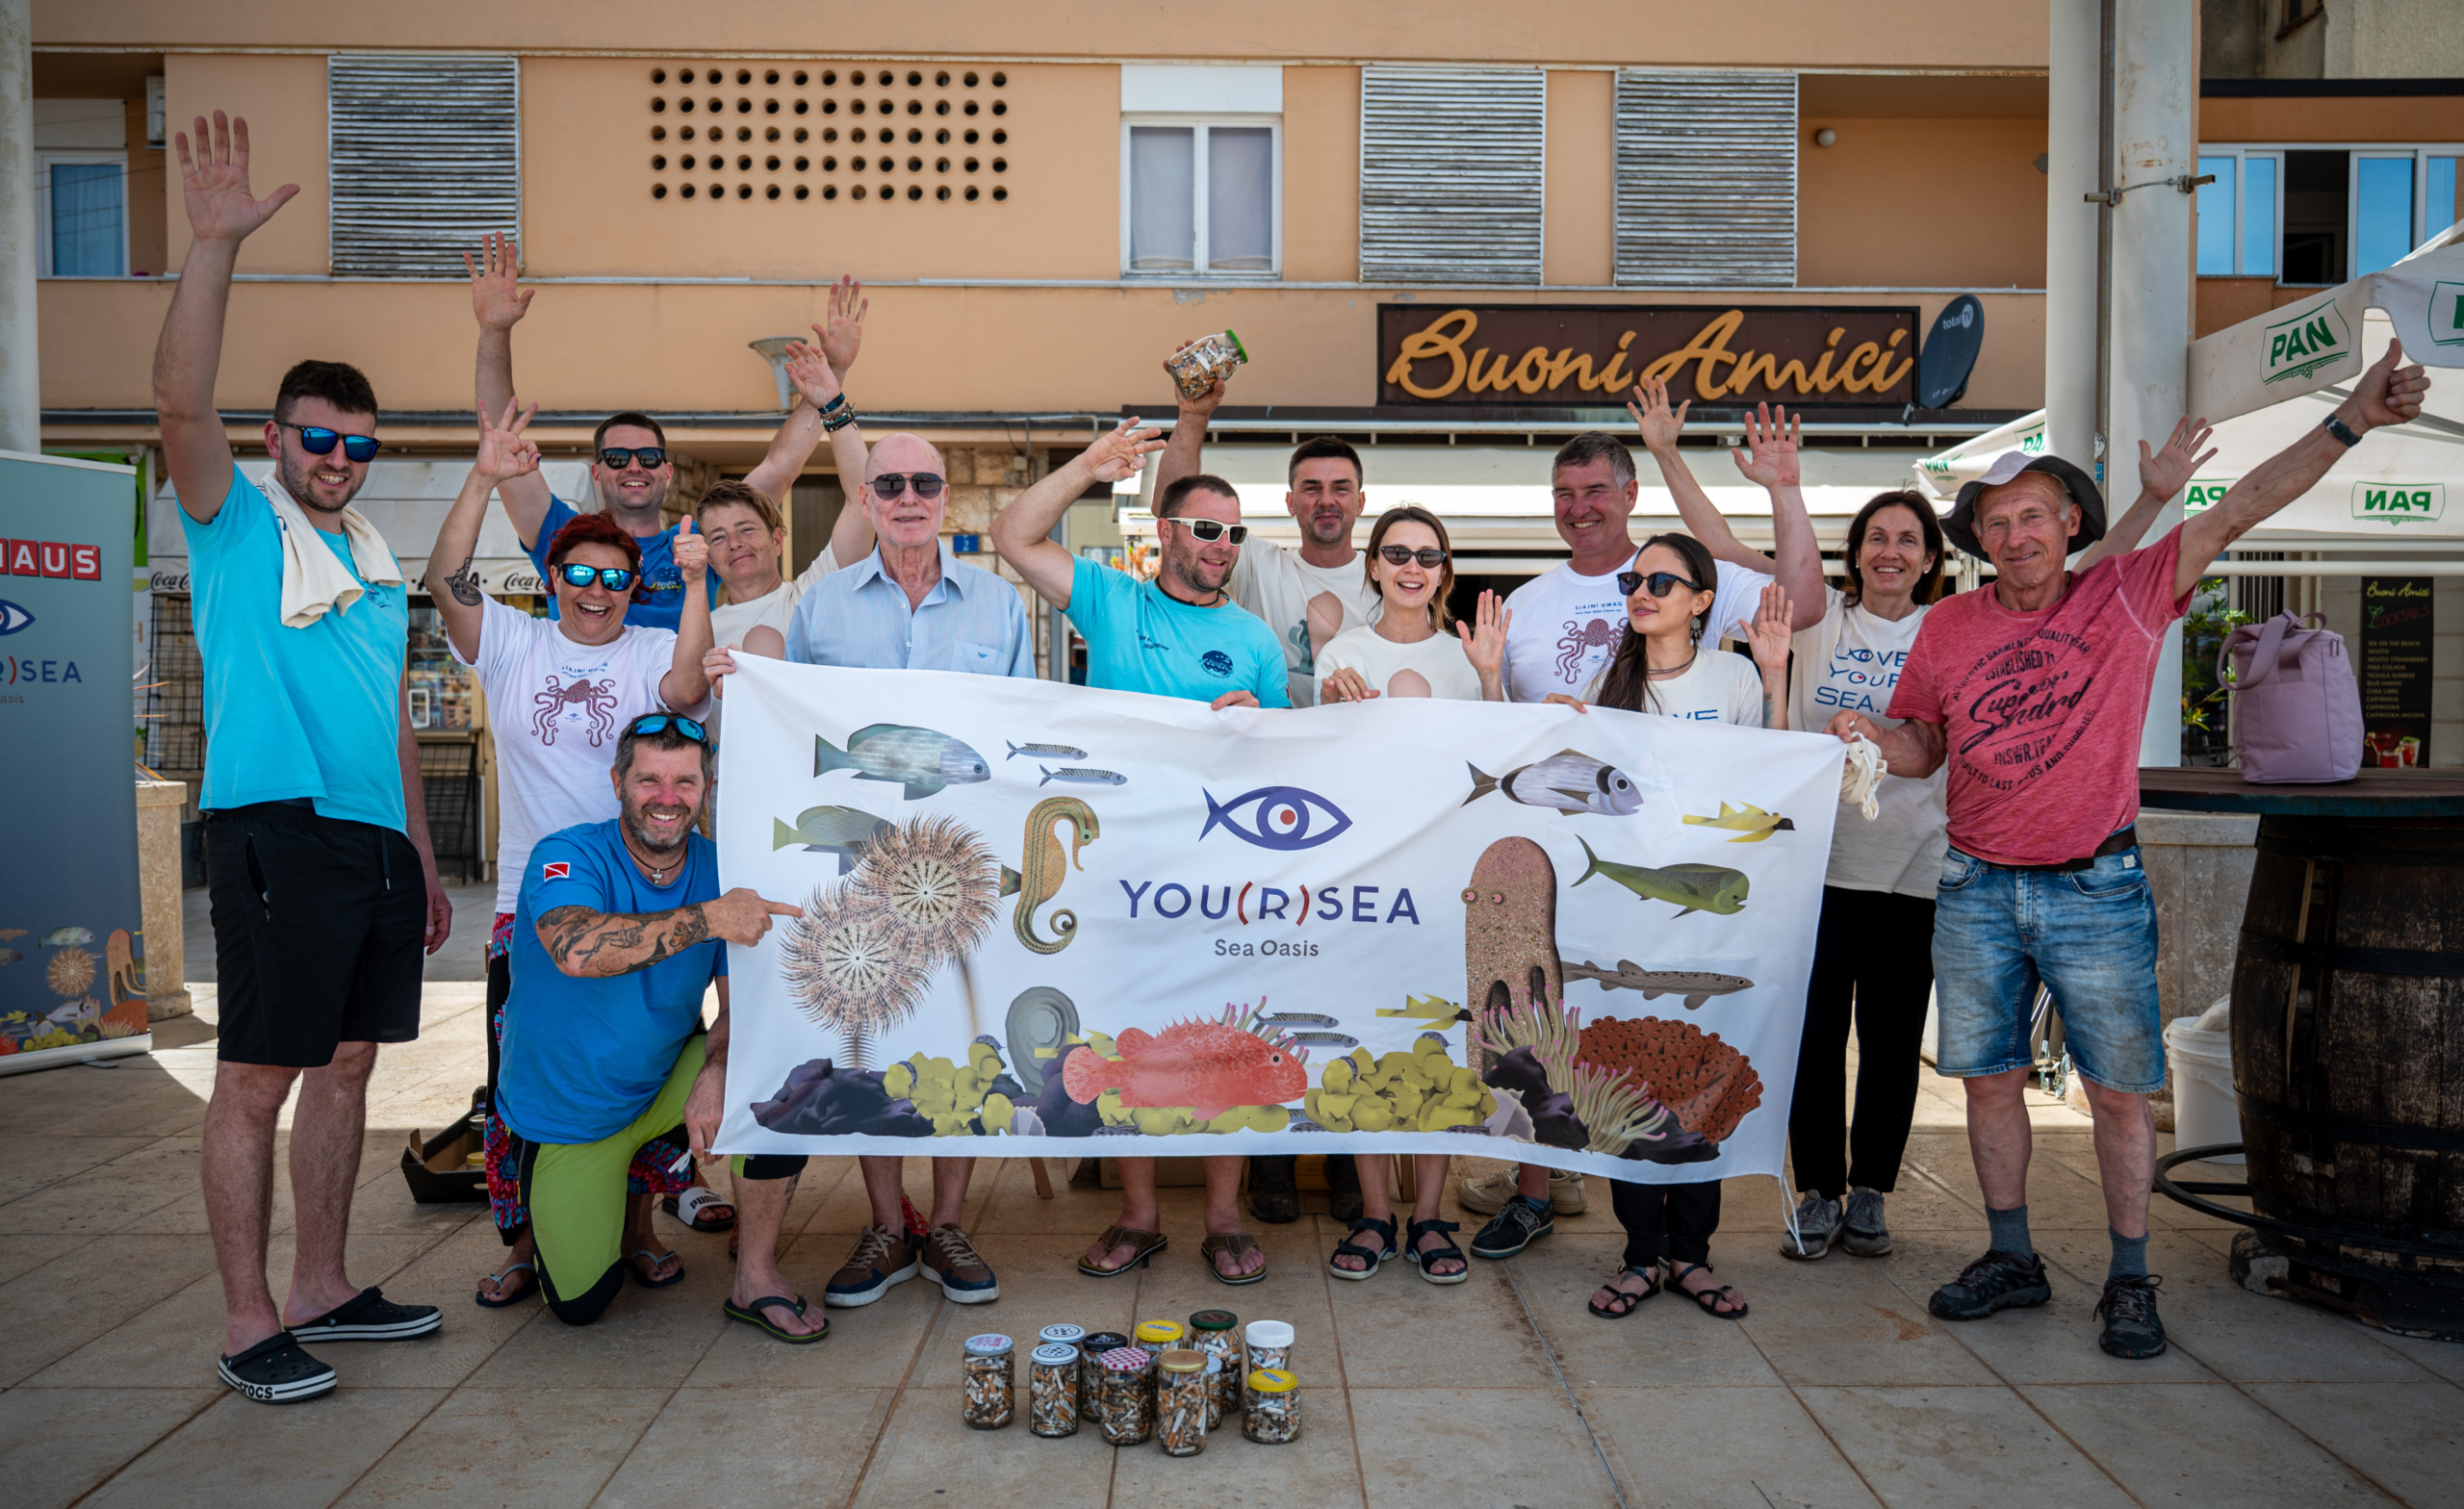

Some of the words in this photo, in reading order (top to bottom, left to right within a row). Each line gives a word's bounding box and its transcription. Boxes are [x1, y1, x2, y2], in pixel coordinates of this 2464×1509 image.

[2271, 316, 2338, 368] PAN
[1386, 309, 1637, 399] Buoni
[1639, 309, 1913, 400] Amici
[2023, 432, 2046, 455] PA
[963, 540, 970, 551] 2
[0, 541, 97, 575] AUS
[503, 572, 546, 592] Coca-C
[2367, 580, 2397, 599] Buoni
[2374, 604, 2430, 628] COCKTAILS
[1814, 686, 1881, 713] SEA.
[2043, 751, 2065, 771] AND
[1118, 880, 1421, 927] YOU(R)SEA
[1214, 938, 1254, 957] Sea
[1260, 939, 1319, 957] Oasis
[239, 1381, 273, 1399] crocs
